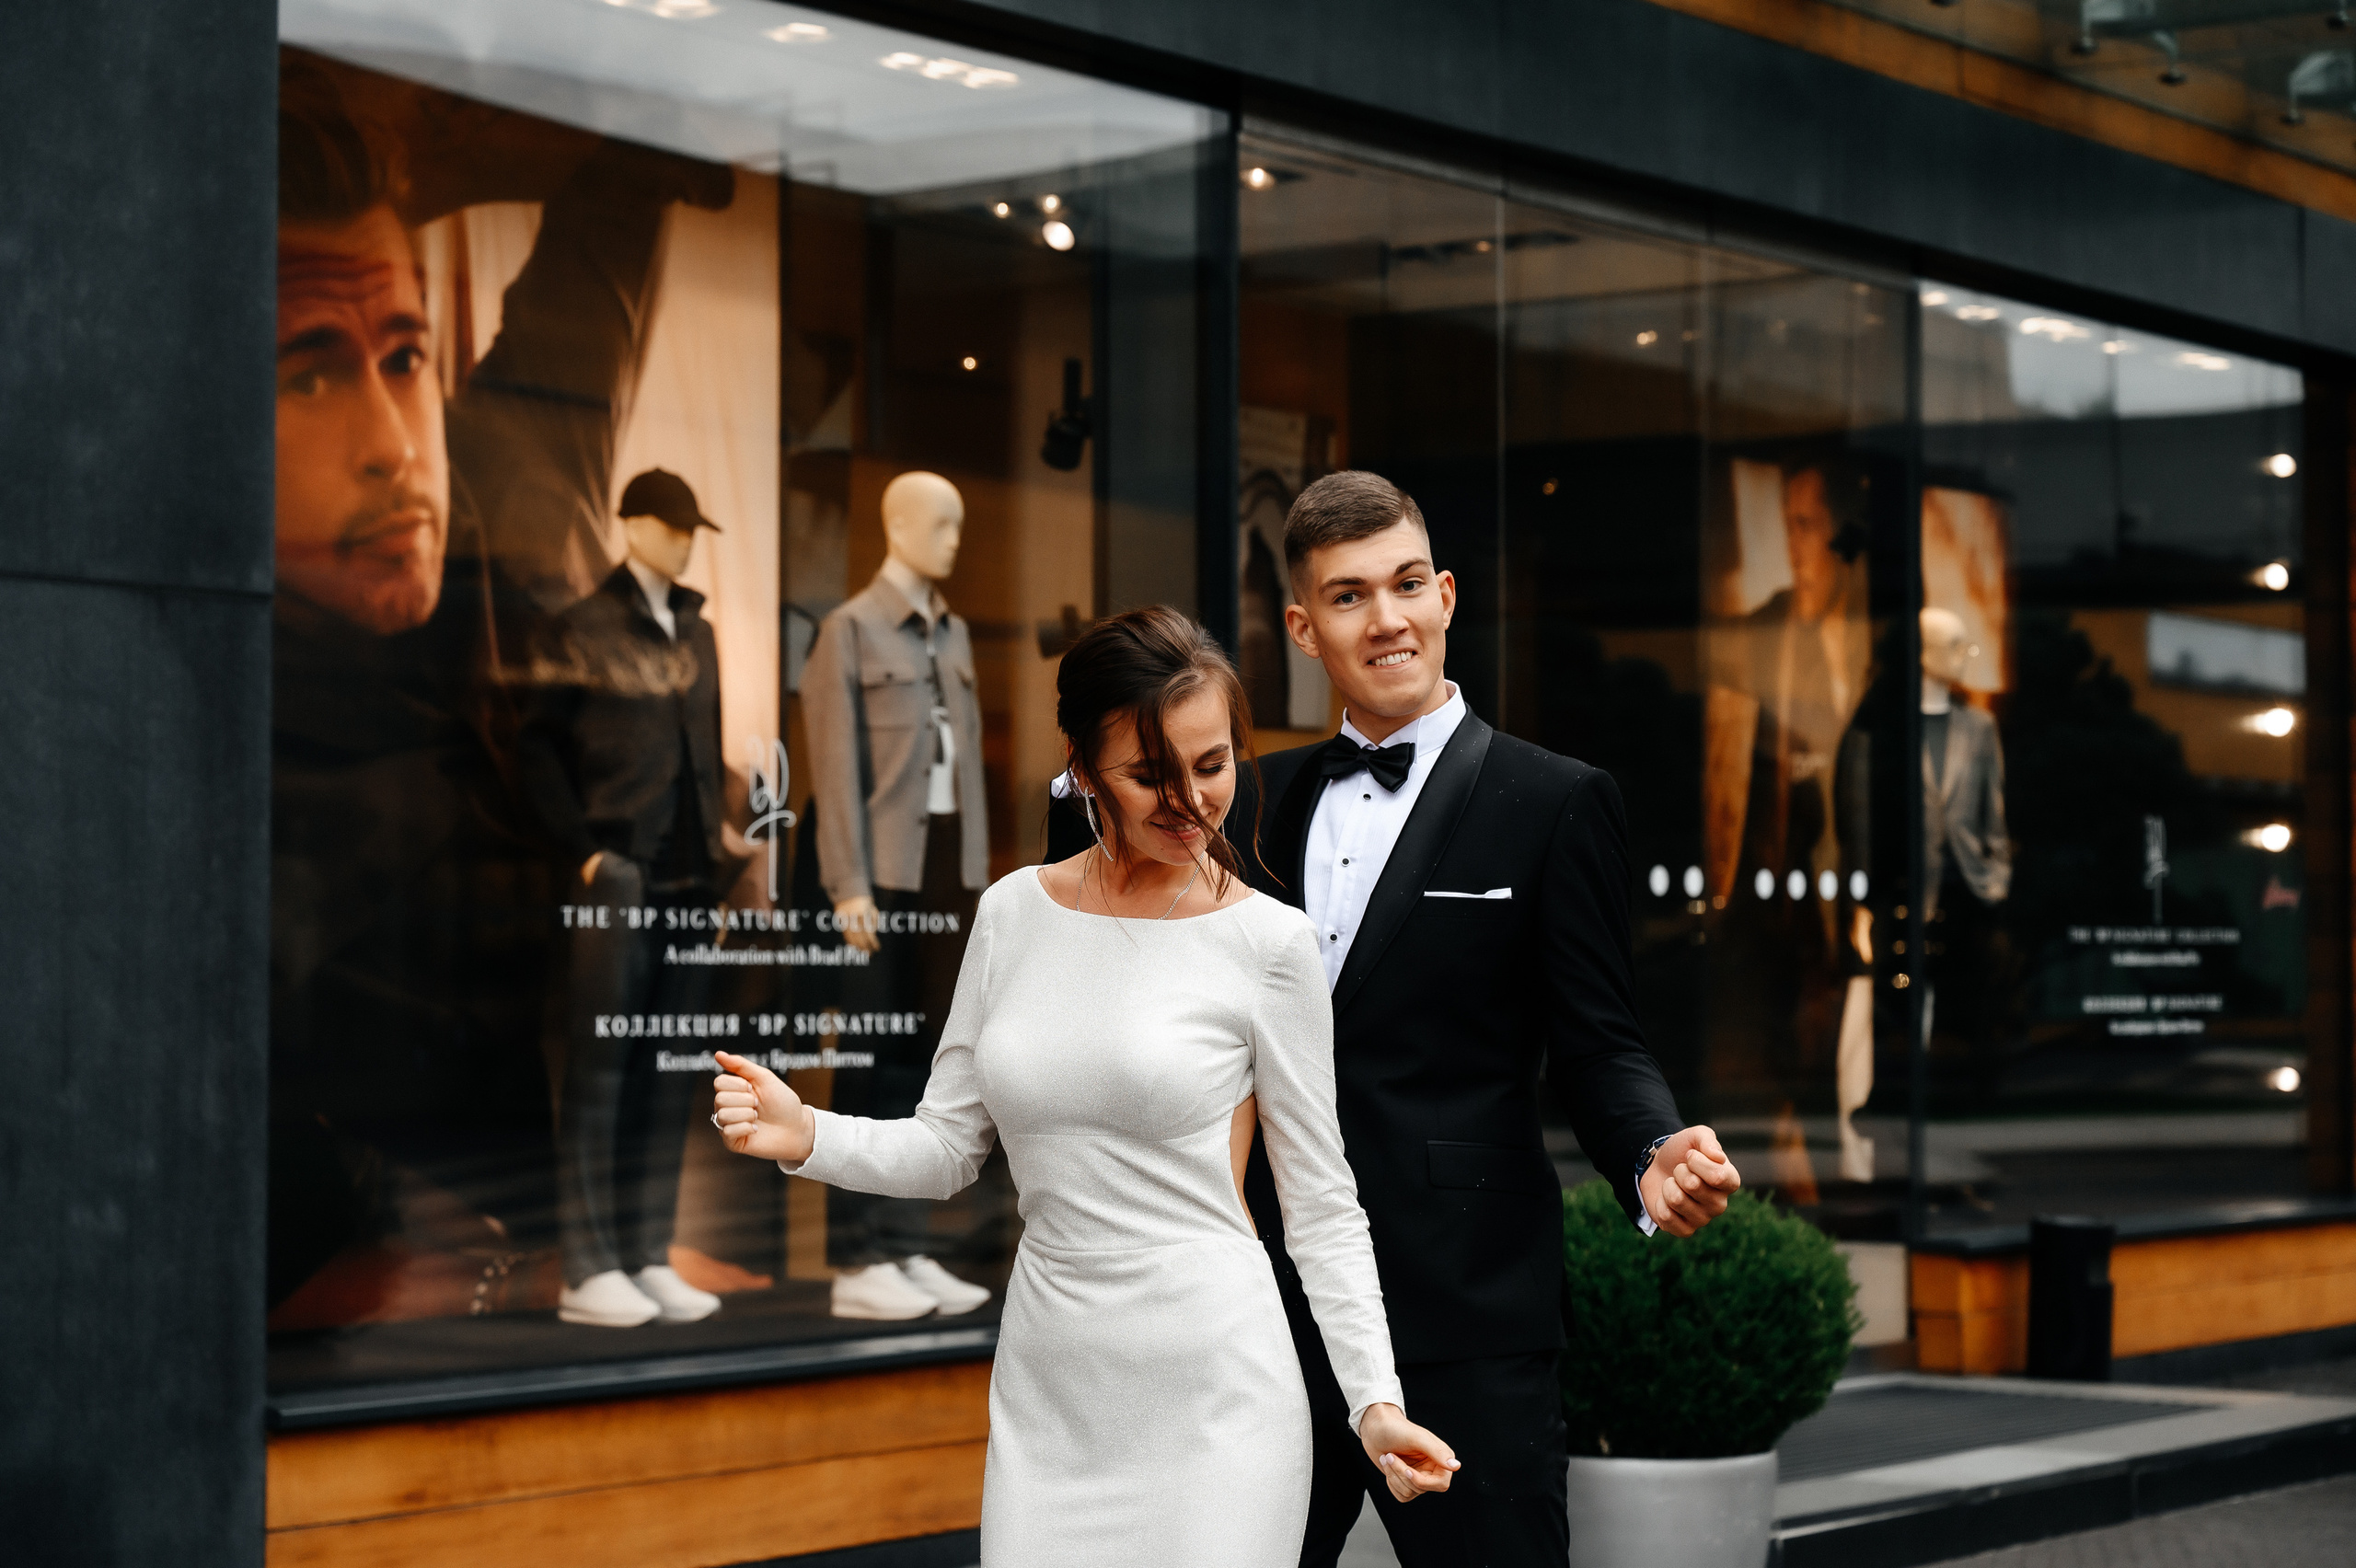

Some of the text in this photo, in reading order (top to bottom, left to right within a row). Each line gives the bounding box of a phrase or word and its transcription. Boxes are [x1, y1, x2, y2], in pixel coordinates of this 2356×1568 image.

[560, 905, 610, 928] THE
[816, 909, 960, 934] COLLECTION
[664, 943, 678, 964] A
[775, 944, 807, 965] with
[595, 1014, 740, 1039] КОЛЛЕКЦИЯ
